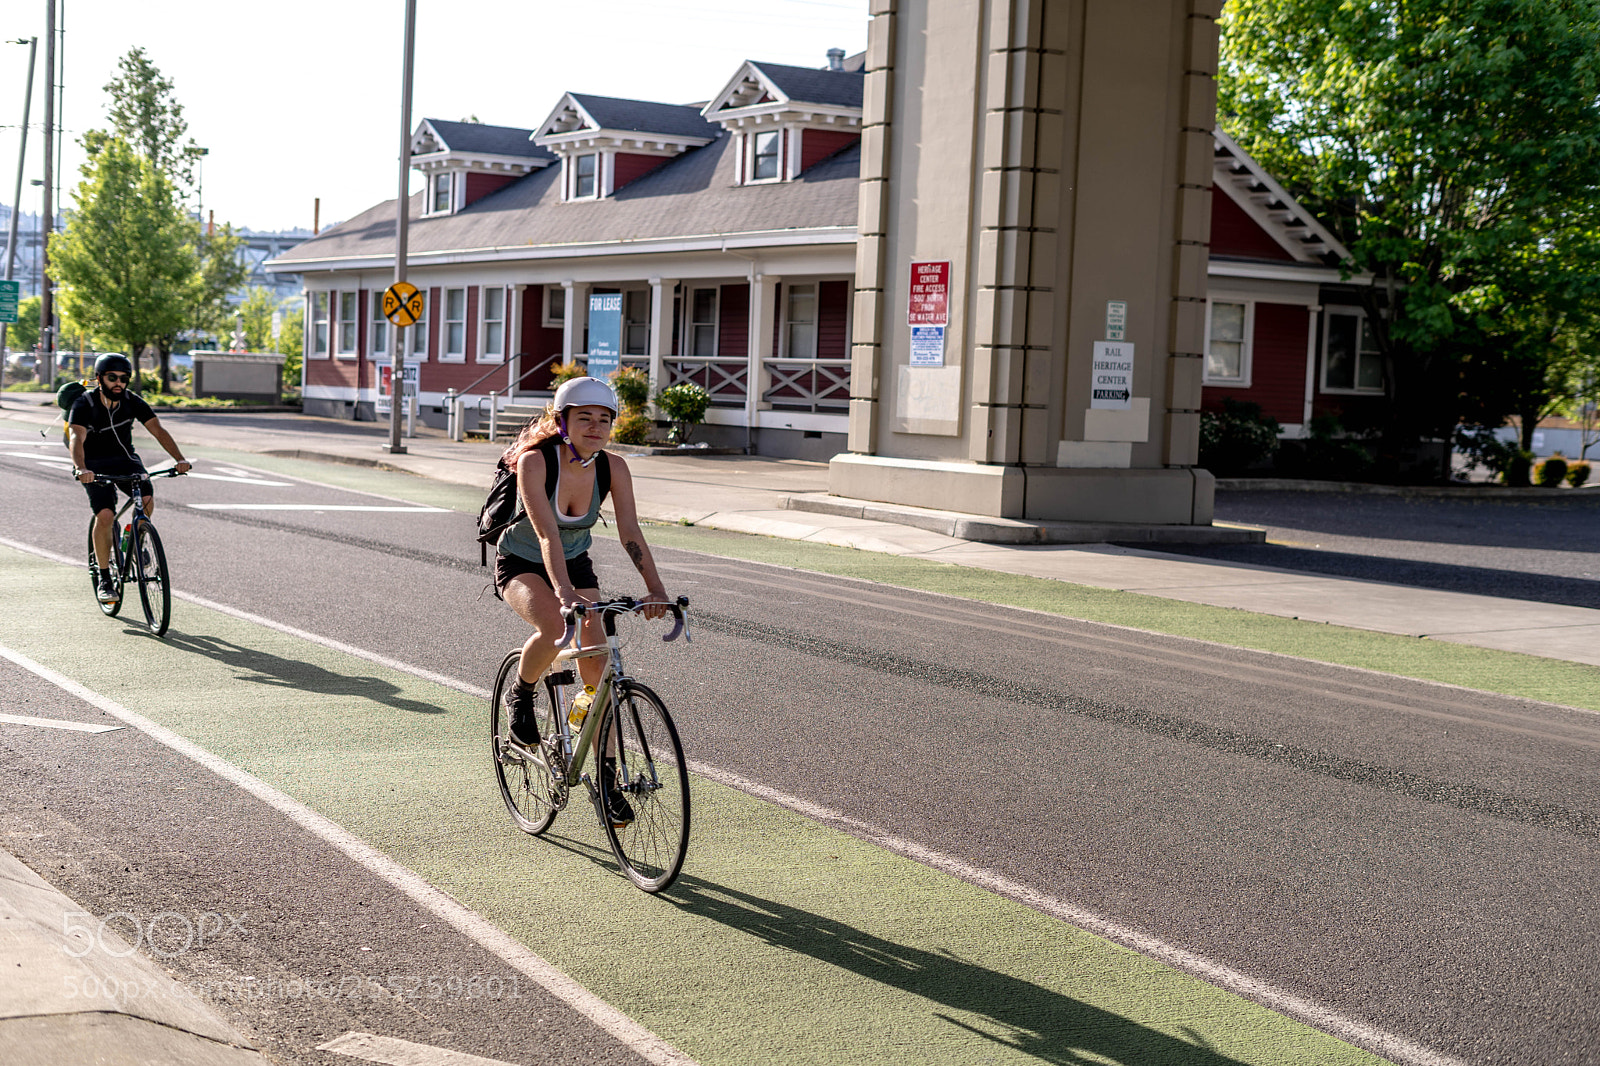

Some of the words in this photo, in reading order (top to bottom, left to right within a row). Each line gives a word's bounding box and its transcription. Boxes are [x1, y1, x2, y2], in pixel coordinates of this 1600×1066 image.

[917, 265, 942, 274] HERITAGE
[920, 275, 939, 283] CENTER
[912, 285, 924, 293] FIRE
[925, 284, 946, 292] ACCESS
[926, 294, 944, 302] NORTH
[385, 297, 394, 308] R
[412, 301, 421, 312] R
[590, 298, 602, 311] FOR
[603, 297, 620, 310] LEASE
[921, 304, 935, 312] FROM
[910, 313, 916, 321] SE
[917, 313, 934, 321] WATER
[936, 313, 946, 321] AVE
[1105, 348, 1122, 356] RAIL
[1094, 361, 1132, 371] HERITAGE
[1097, 376, 1126, 384] CENTER
[1096, 390, 1126, 399] PARKING
